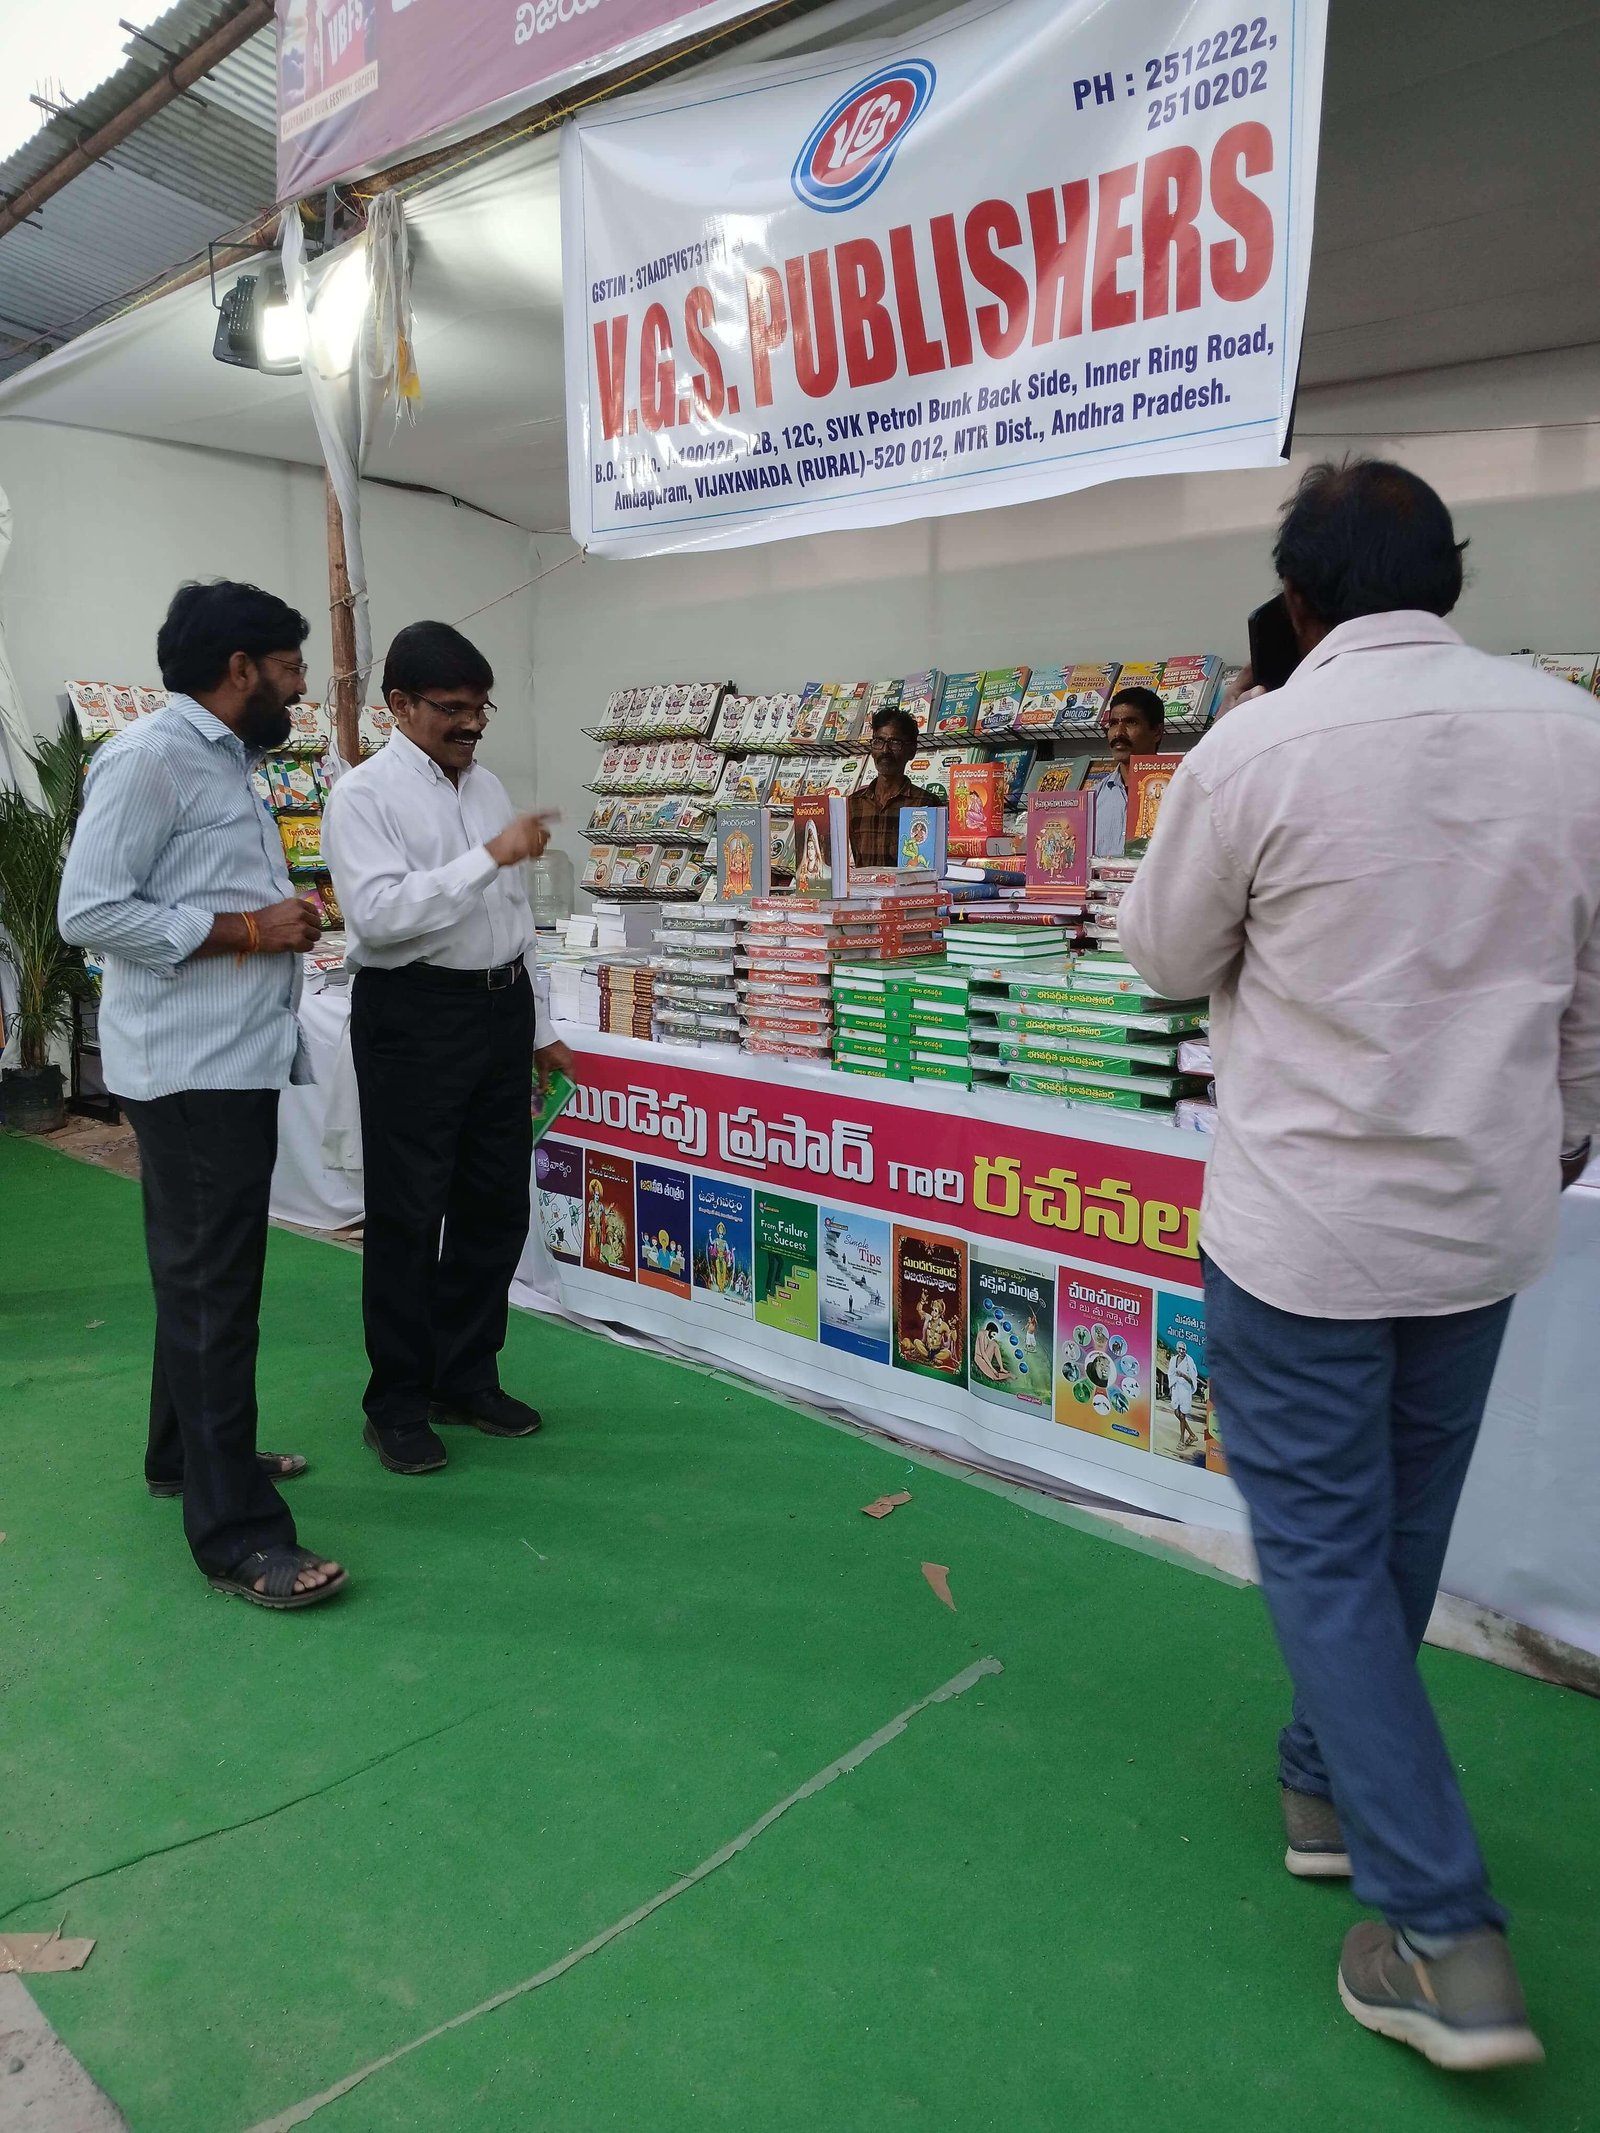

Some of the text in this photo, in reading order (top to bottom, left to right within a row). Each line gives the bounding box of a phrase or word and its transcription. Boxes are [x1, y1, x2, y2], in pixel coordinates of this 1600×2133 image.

[1073, 72, 1115, 110] PH
[1145, 16, 1277, 91] 2512222,
[1147, 60, 1268, 131] 2510202
[592, 274, 626, 303] GSTIN
[593, 121, 1273, 441] V.G.S. PUBLISHERS
[596, 461, 617, 483] B.O.
[782, 422, 823, 449] 12C,
[826, 414, 864, 442] SVK
[867, 402, 922, 434] Petrol
[929, 392, 972, 423] Bunk
[977, 379, 1021, 412] Back
[1028, 369, 1077, 400] Side,
[1085, 356, 1140, 388] Inner
[1148, 345, 1197, 375] Ring
[1207, 323, 1273, 363] Road,
[615, 378, 1231, 511] Ambapuram, VIJAYAWADA (RURAL)-520 012, NTR Dist., Andhra Pradesh.
[1064, 709, 1091, 718] BIOLOGY
[719, 1106, 875, 1184] ప్రసాద్
[888, 1161, 965, 1205] గారి
[760, 1219, 809, 1239] From Failure
[763, 1232, 807, 1251] To Success
[844, 1234, 869, 1249] Simple
[858, 1248, 882, 1266] Tips
[903, 1256, 957, 1279] సుందరకాండ
[979, 1273, 1007, 1295] సక్సెస్
[1008, 1281, 1040, 1304] మంత్ర
[1067, 1280, 1141, 1315] చరాచరాలు
